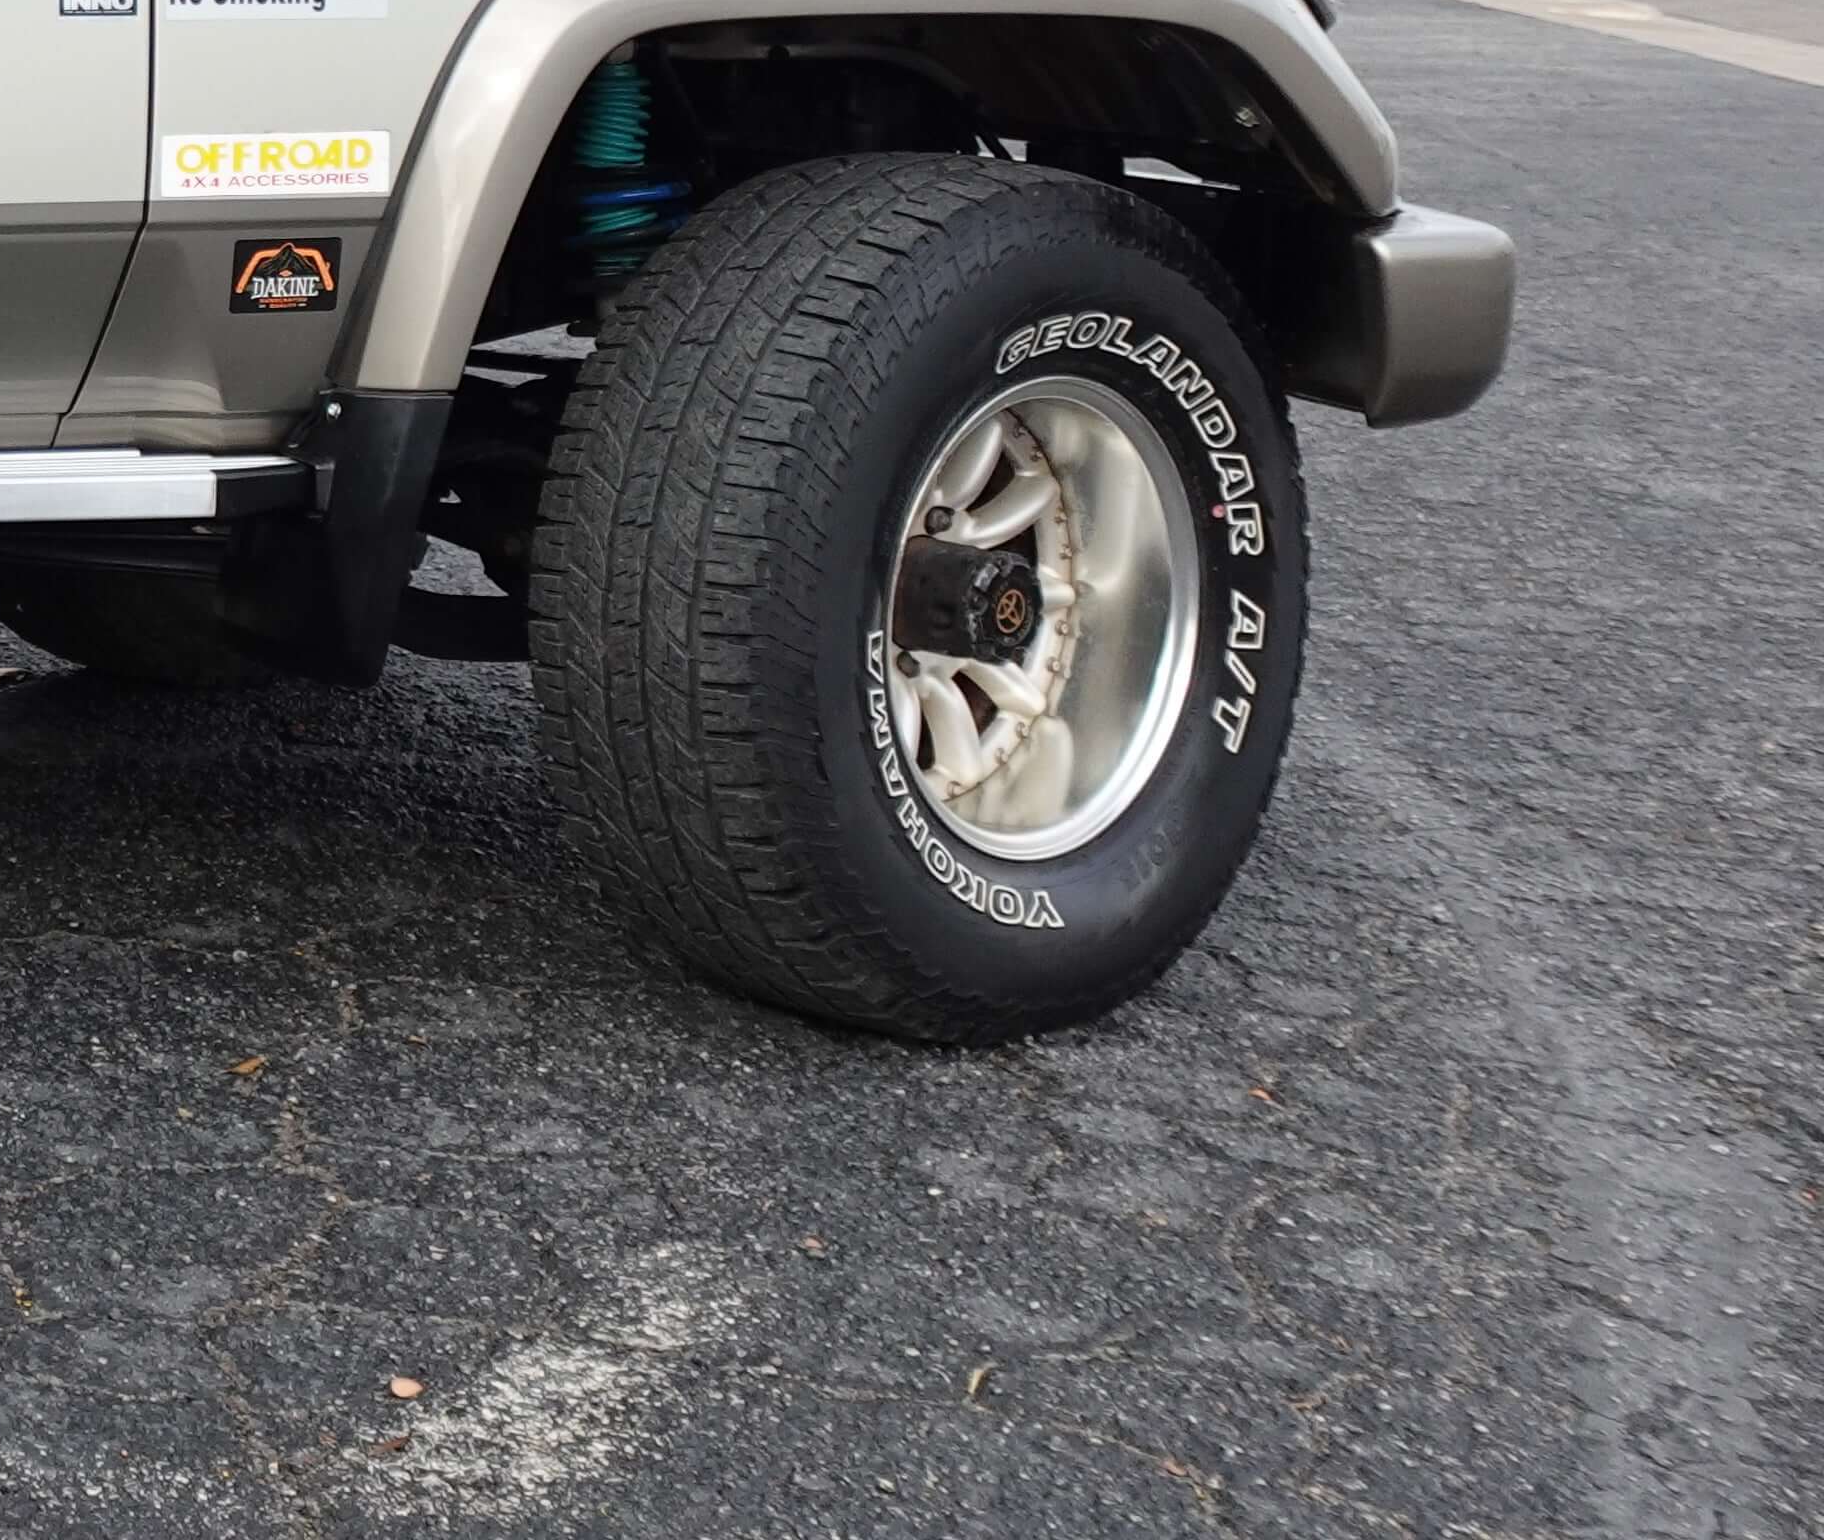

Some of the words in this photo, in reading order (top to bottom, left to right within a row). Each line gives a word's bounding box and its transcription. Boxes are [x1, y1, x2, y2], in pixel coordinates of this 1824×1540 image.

[227, 172, 370, 187] ACCESSORIES
[250, 276, 320, 299] DAKINE
[995, 309, 1265, 556] GEOLANDAR
[1212, 587, 1266, 754] A/T
[866, 628, 1065, 929] YOKOHAMA
